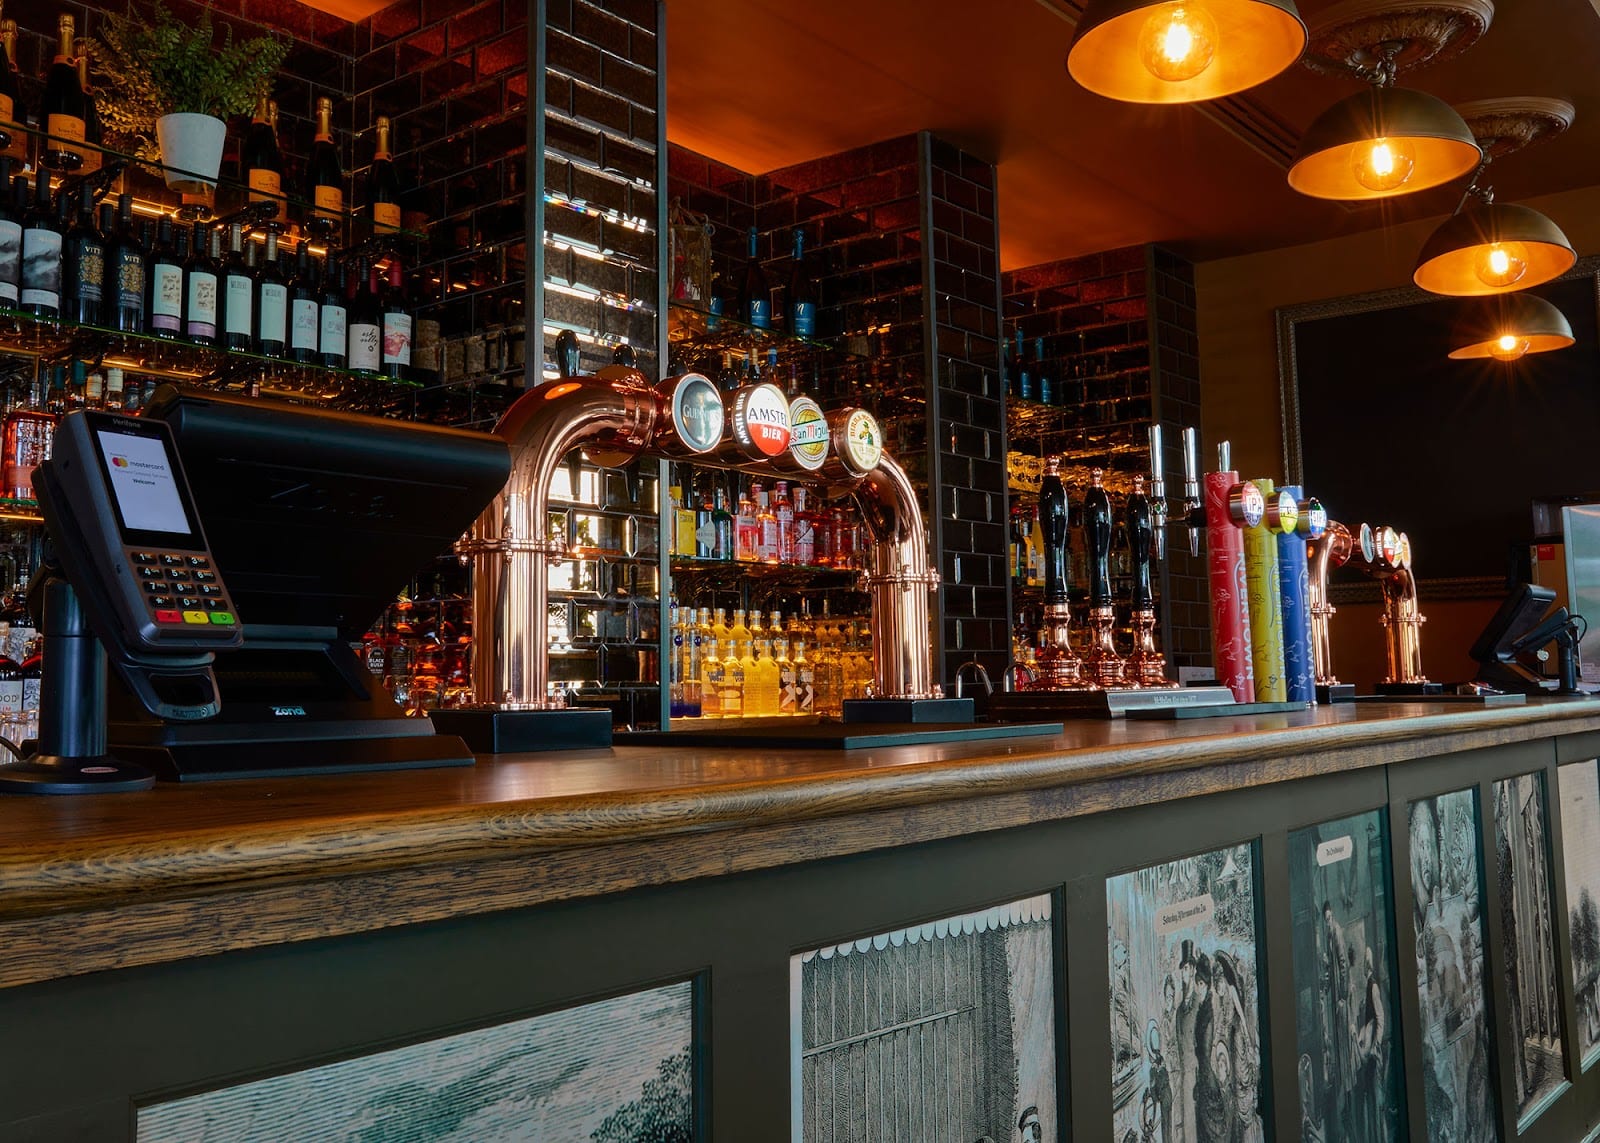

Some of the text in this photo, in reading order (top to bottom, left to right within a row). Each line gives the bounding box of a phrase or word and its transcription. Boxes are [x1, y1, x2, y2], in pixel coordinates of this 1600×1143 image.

[749, 408, 788, 426] AMSTEL
[762, 427, 782, 441] BIER
[130, 461, 164, 470] mastercard
[132, 478, 155, 486] Welcome
[1248, 496, 1262, 512] IPA
[140, 553, 145, 561] 1
[165, 555, 172, 563] 2
[191, 556, 198, 564] 3
[144, 567, 151, 575] 4
[171, 569, 178, 577] 5
[197, 571, 204, 579] 6
[149, 582, 155, 590] 7
[177, 583, 184, 591] 8
[203, 584, 209, 593] 9
[184, 598, 190, 606] 0
